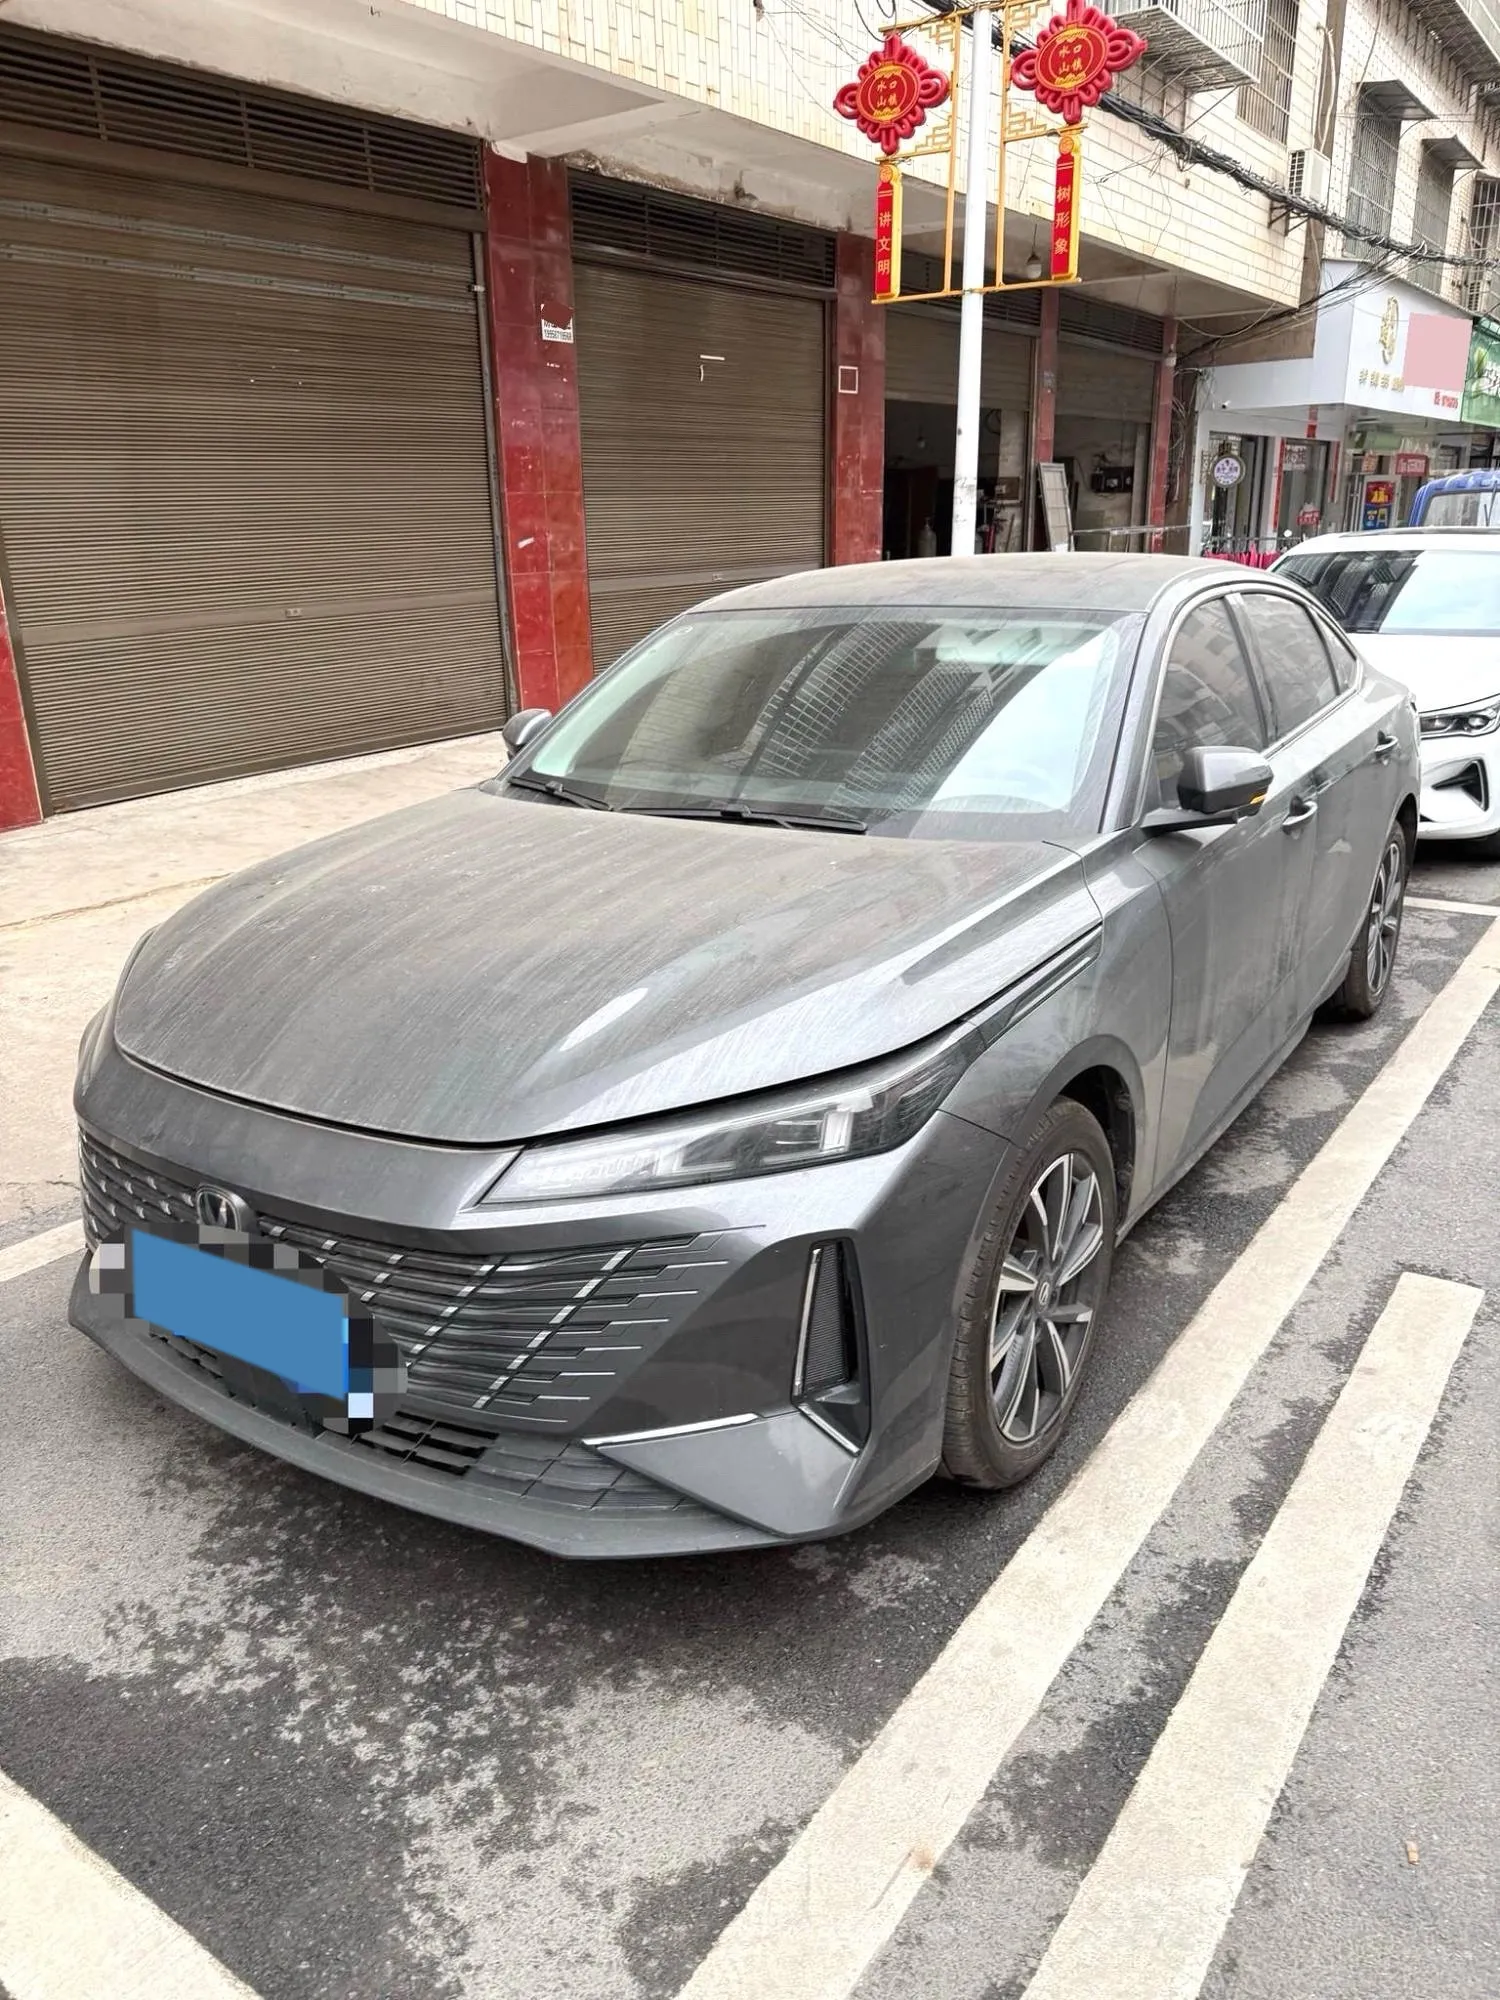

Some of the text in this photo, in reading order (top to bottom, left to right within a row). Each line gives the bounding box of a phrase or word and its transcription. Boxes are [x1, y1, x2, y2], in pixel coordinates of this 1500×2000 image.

[877, 212, 892, 276] 讲文明
[1054, 185, 1071, 255] 树形象
